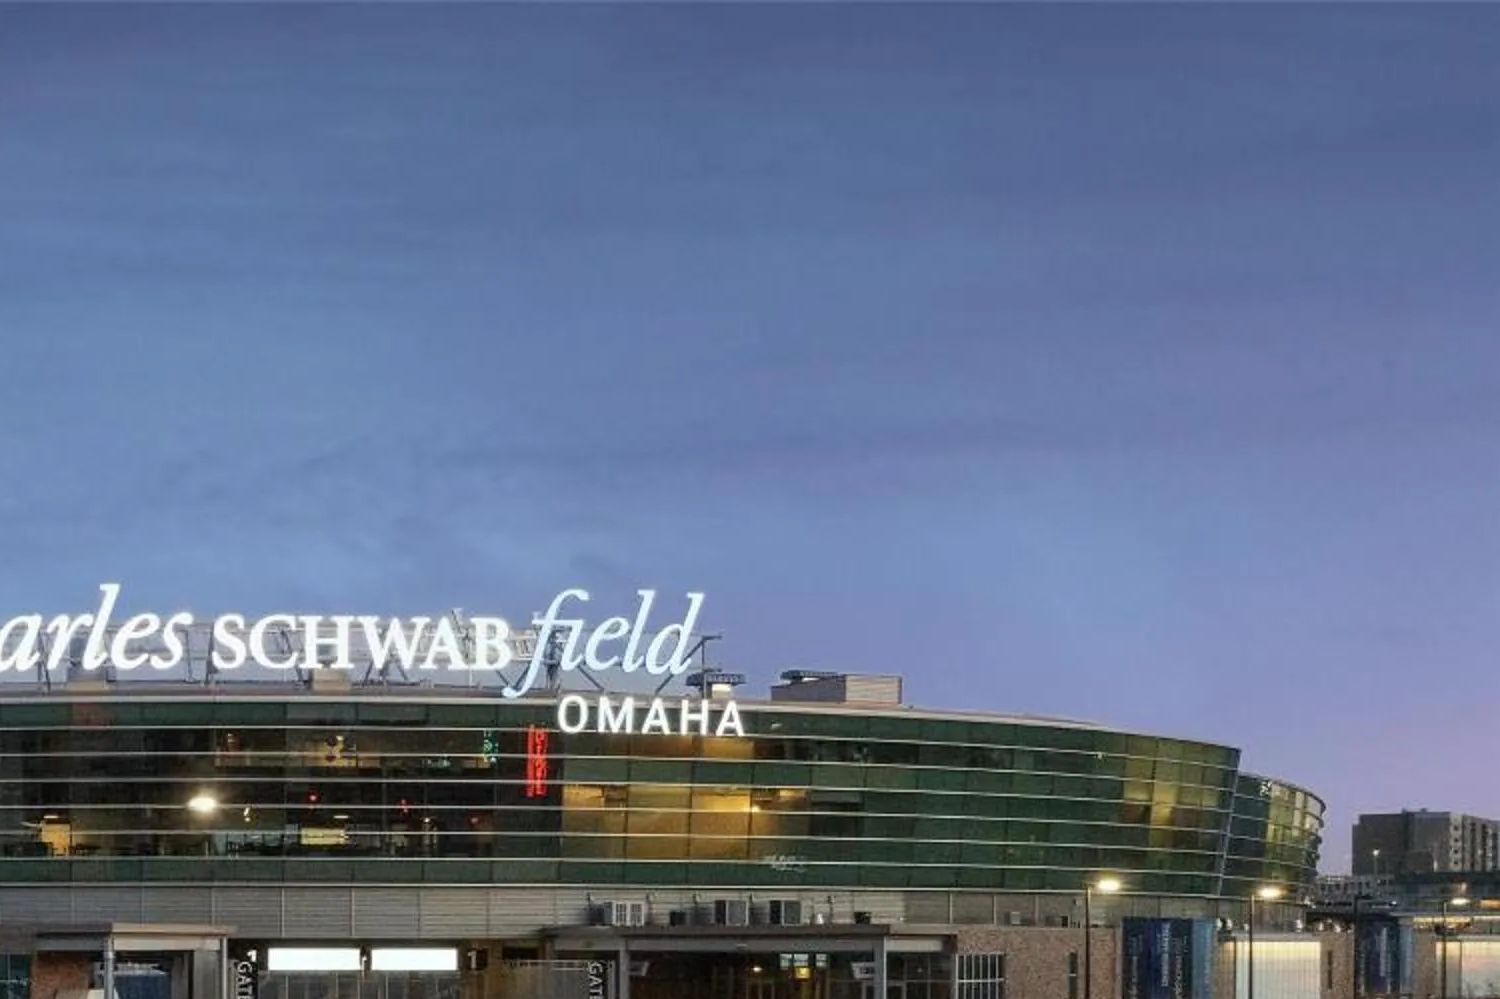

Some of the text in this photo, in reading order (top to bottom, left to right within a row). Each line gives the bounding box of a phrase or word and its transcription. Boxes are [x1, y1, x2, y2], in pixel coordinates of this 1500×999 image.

[211, 613, 514, 672] SCHWAB
[502, 588, 706, 699] field
[556, 694, 747, 738] OMAHA
